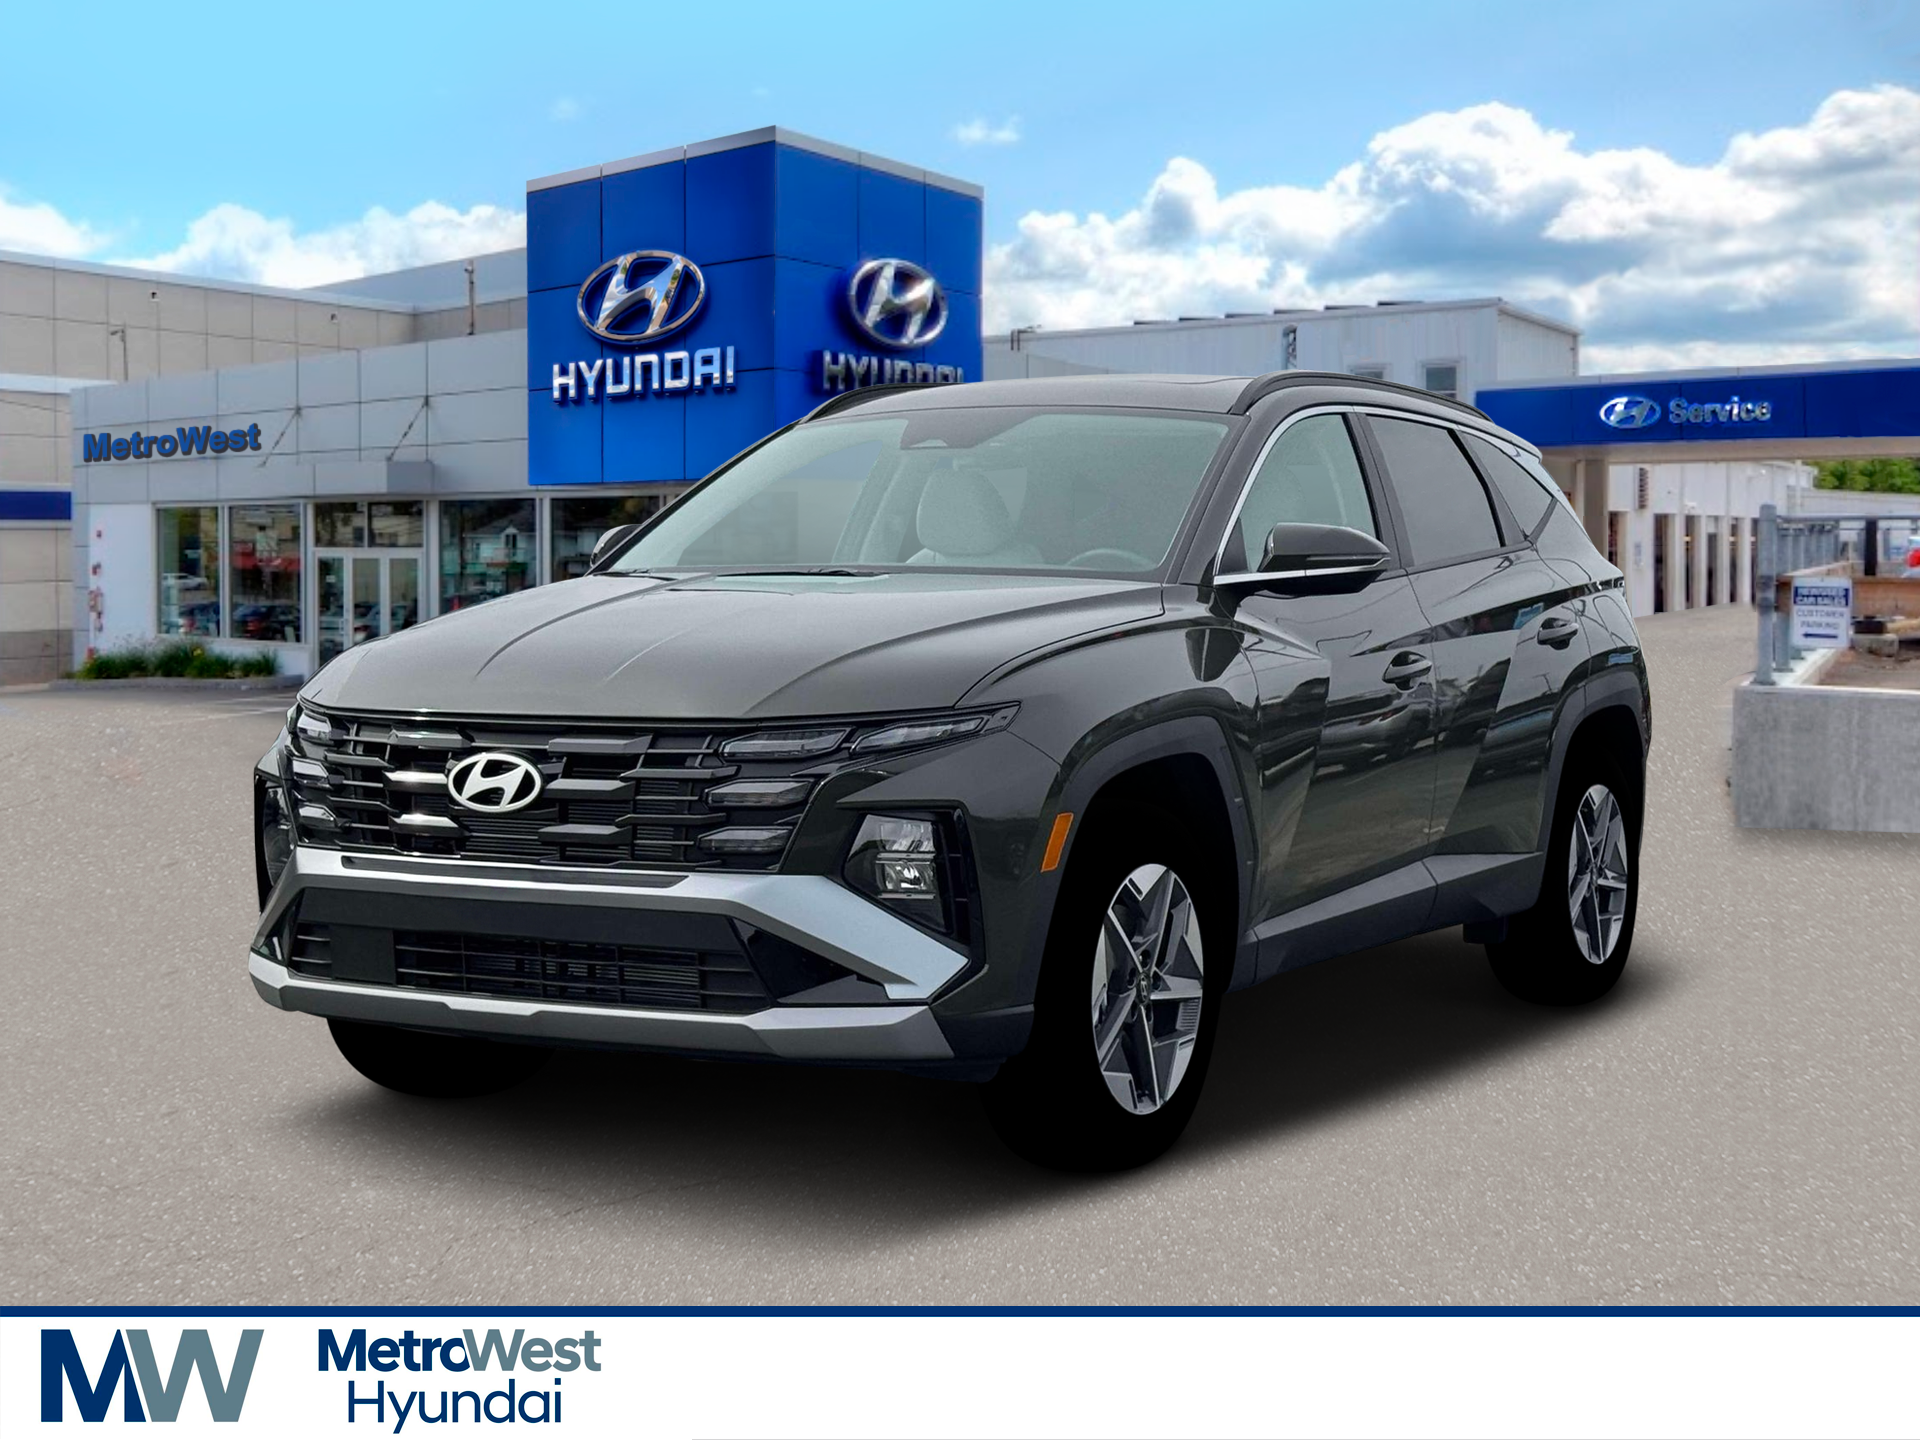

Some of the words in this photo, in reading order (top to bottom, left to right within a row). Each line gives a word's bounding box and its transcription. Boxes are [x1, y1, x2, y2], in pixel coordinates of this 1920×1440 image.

[552, 346, 735, 401] HYUNDAI
[1668, 395, 1772, 424] Service
[83, 423, 262, 462] MetroWest
